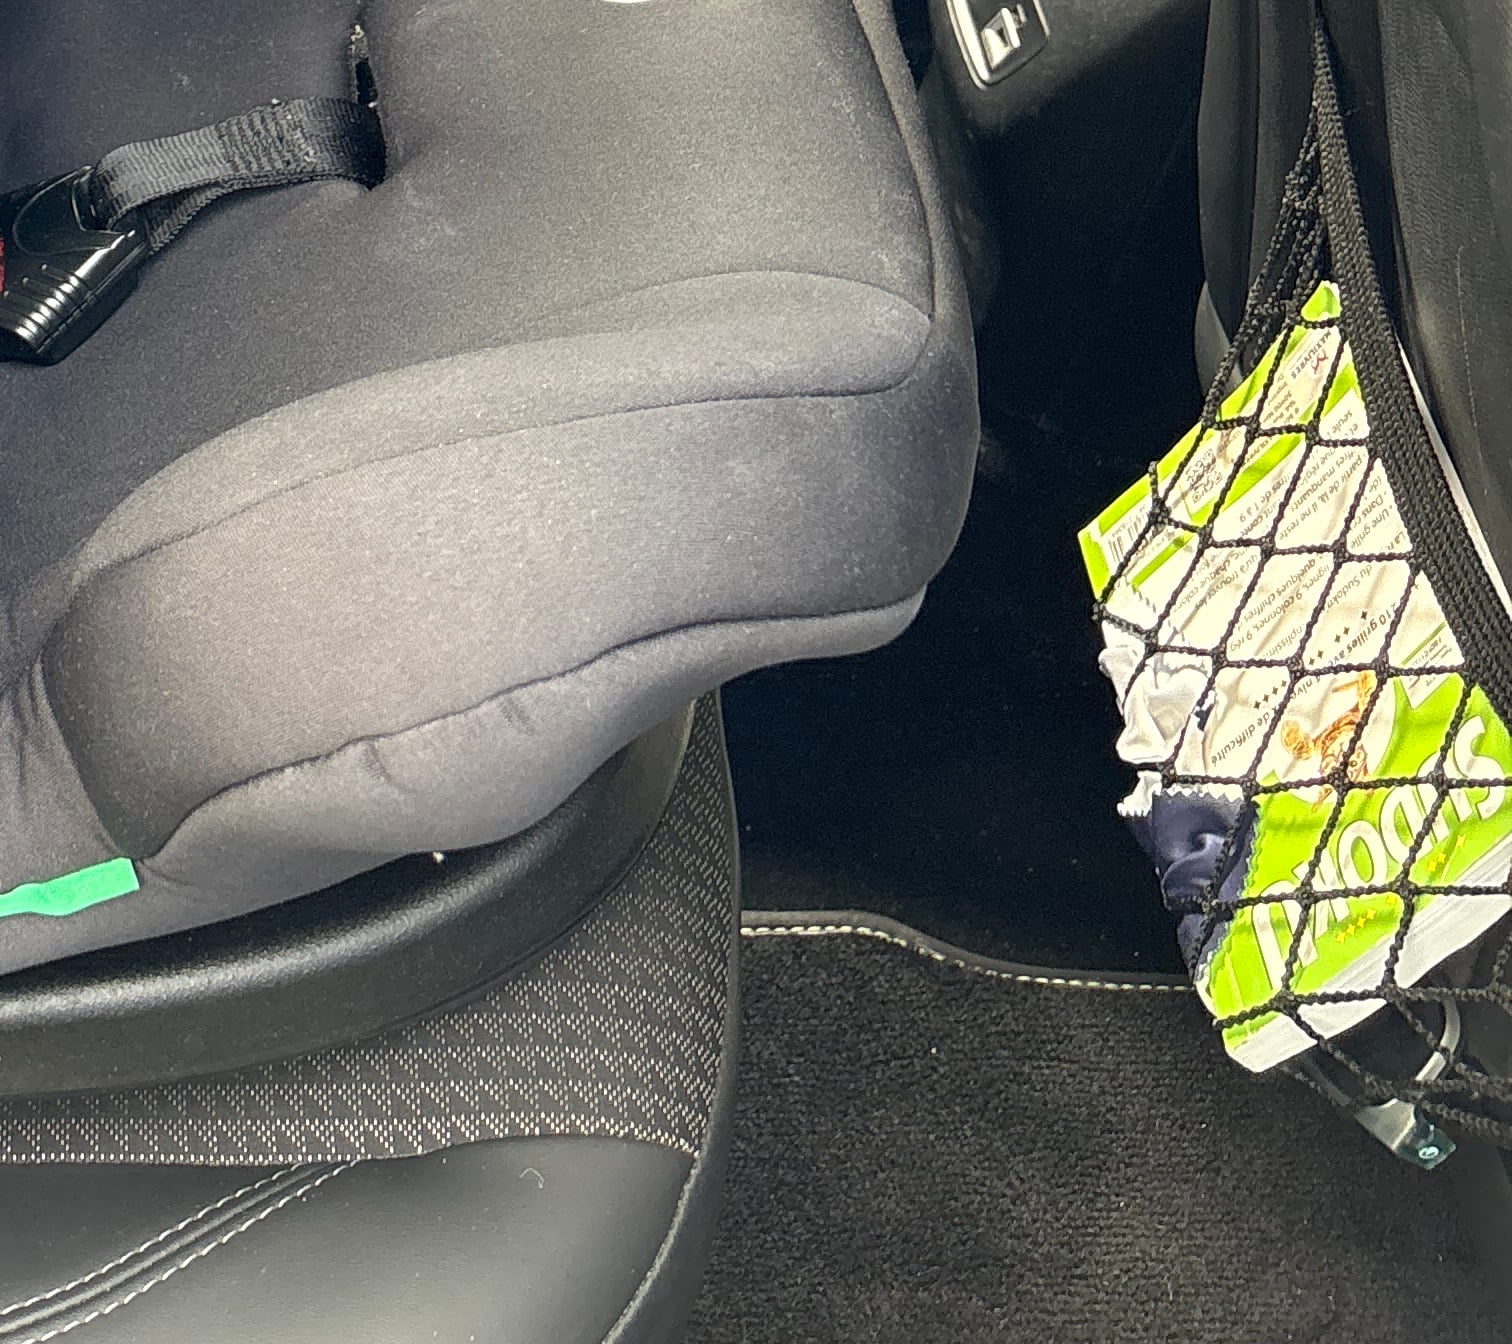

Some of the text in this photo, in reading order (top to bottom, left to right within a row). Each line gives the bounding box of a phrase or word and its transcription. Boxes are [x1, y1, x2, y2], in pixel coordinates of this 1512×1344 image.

[1290, 330, 1332, 380] MAXILIVRES
[1330, 408, 1353, 434] seule
[1339, 453, 1363, 483] partir
[1259, 489, 1275, 504] de
[1327, 479, 1340, 495] de
[1298, 506, 1312, 522] ne
[1310, 500, 1319, 513] il
[1370, 507, 1390, 529] Une
[1278, 517, 1300, 541] reste
[1344, 522, 1371, 549] grille
[1393, 529, 1406, 545] La
[1242, 493, 1384, 623] Dans quelques chiffres
[1358, 561, 1373, 578] du
[1199, 555, 1231, 589] chaque
[1291, 587, 1303, 601] 9
[1251, 593, 1295, 632] colonnes,
[1244, 628, 1253, 641] 9
[1345, 617, 1378, 654] grilles
[1255, 710, 1274, 727] de
[1210, 722, 1256, 768] difficulté
[1251, 714, 1505, 992] SUDOKU
